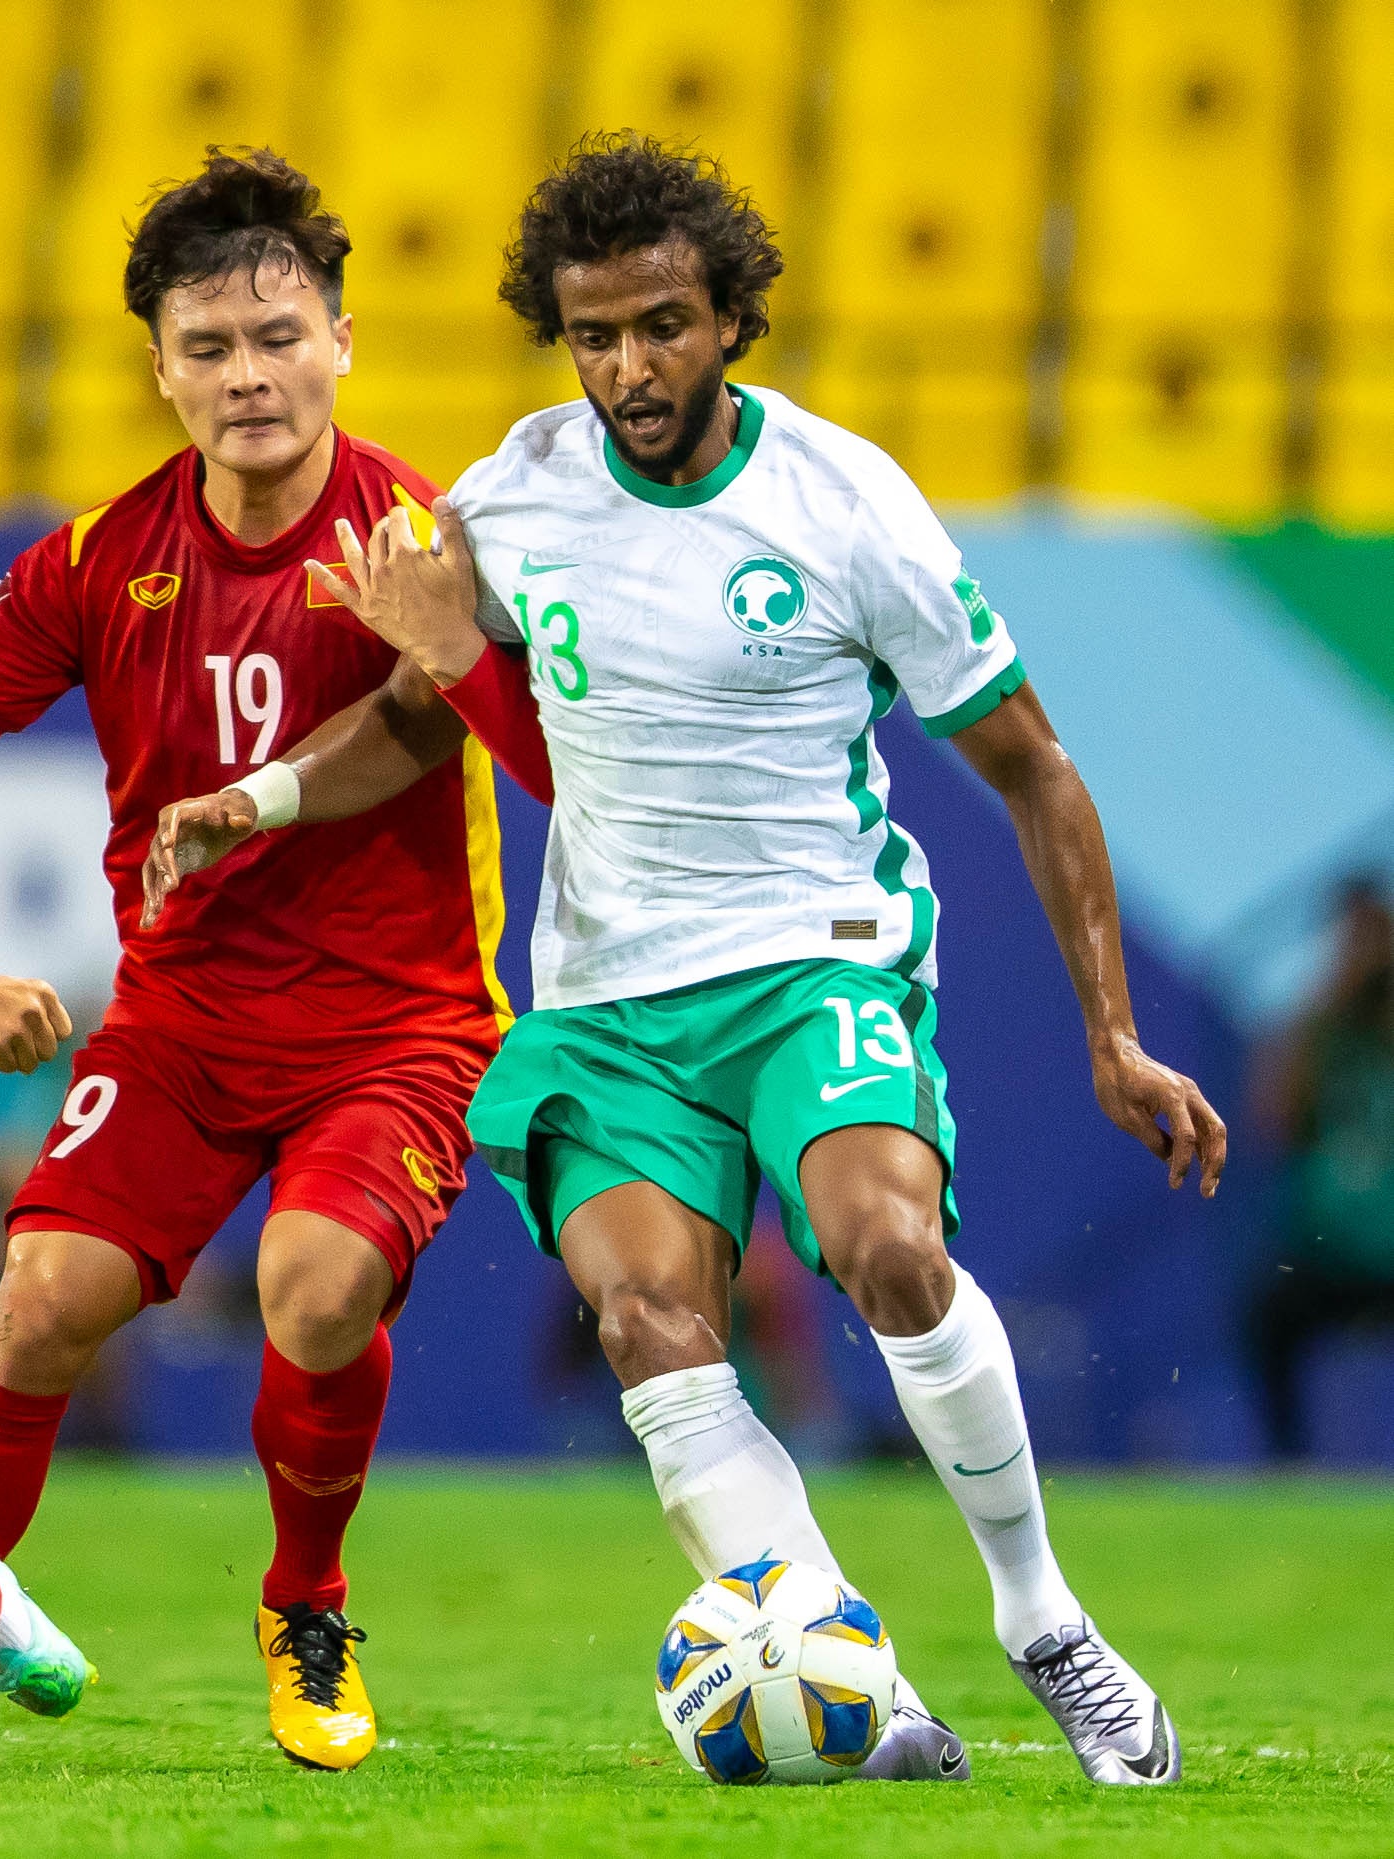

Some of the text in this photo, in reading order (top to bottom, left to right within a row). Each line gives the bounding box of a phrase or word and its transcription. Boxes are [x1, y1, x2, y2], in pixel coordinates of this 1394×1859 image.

[513, 592, 588, 701] 13
[742, 644, 783, 658] KSA
[205, 653, 283, 765] 19
[822, 997, 914, 1069] 13
[673, 1662, 733, 1725] molten
